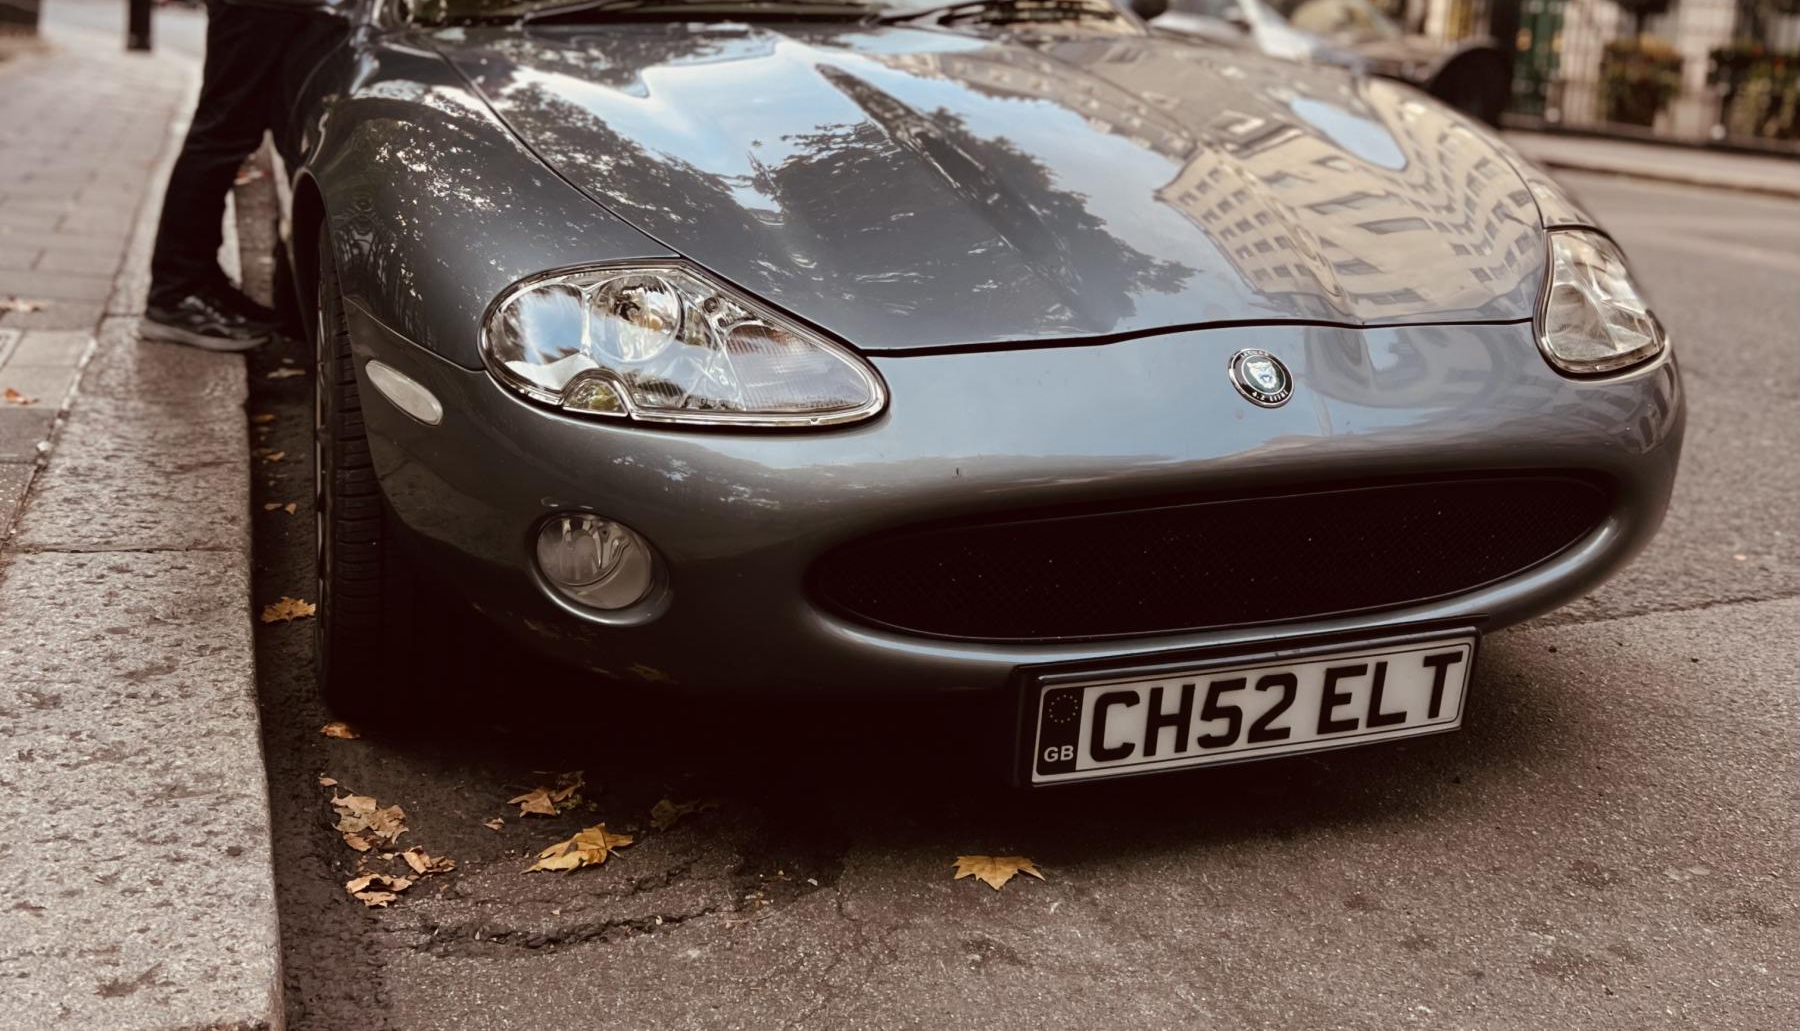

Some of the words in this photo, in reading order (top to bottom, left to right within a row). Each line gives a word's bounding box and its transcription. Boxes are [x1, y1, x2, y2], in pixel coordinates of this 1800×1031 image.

[1089, 672, 1298, 763] CH52
[1316, 650, 1464, 736] ELT
[1043, 744, 1074, 763] GB
